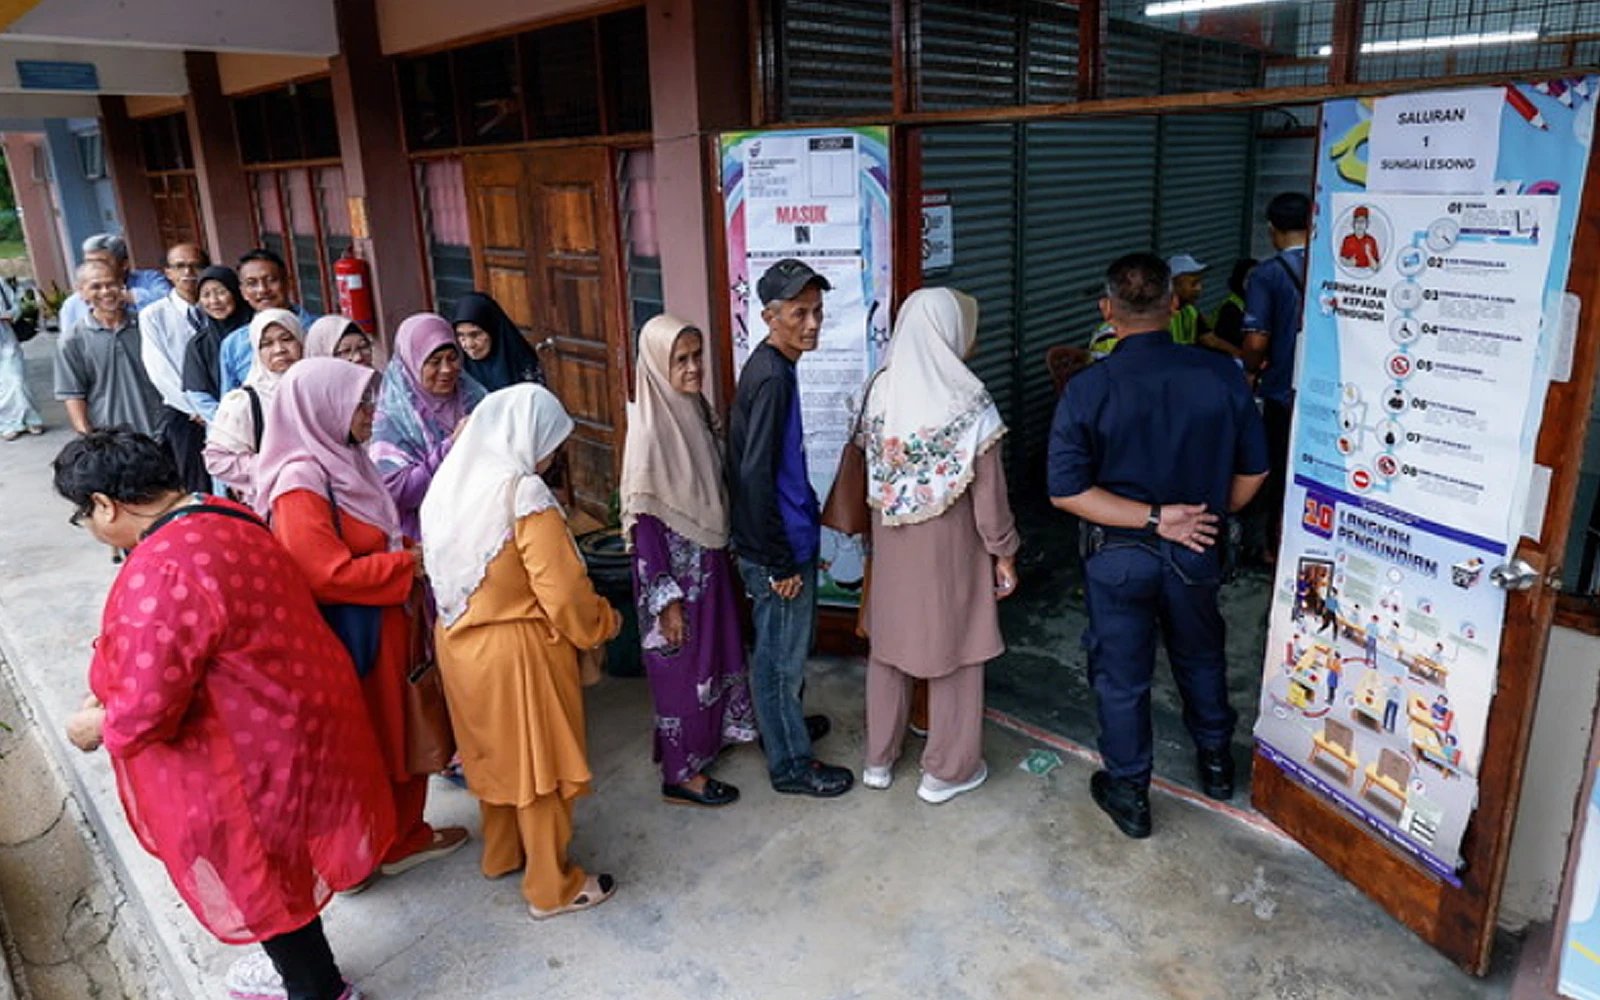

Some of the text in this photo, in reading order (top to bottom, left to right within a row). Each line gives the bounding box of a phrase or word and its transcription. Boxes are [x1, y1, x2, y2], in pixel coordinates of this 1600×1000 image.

[1397, 108, 1466, 125] SALURAN
[1422, 135, 1430, 147] 1
[1380, 158, 1476, 170] SUNGAI LESONG
[776, 205, 828, 224] MASUK
[1447, 202, 1462, 214] 01
[1426, 256, 1443, 268] 02
[1321, 280, 1387, 298] PERINGATAN
[1422, 289, 1439, 301] 03
[1343, 297, 1385, 310] KEPADA
[1421, 322, 1439, 334] 04
[1416, 359, 1433, 371] 05
[1411, 397, 1427, 410] 06
[1406, 432, 1420, 444] 07
[1401, 464, 1418, 477] 08
[1304, 501, 1334, 531] 10
[1339, 510, 1411, 546] LANGKAH
[1337, 526, 1438, 576] PENGUNDIAN
